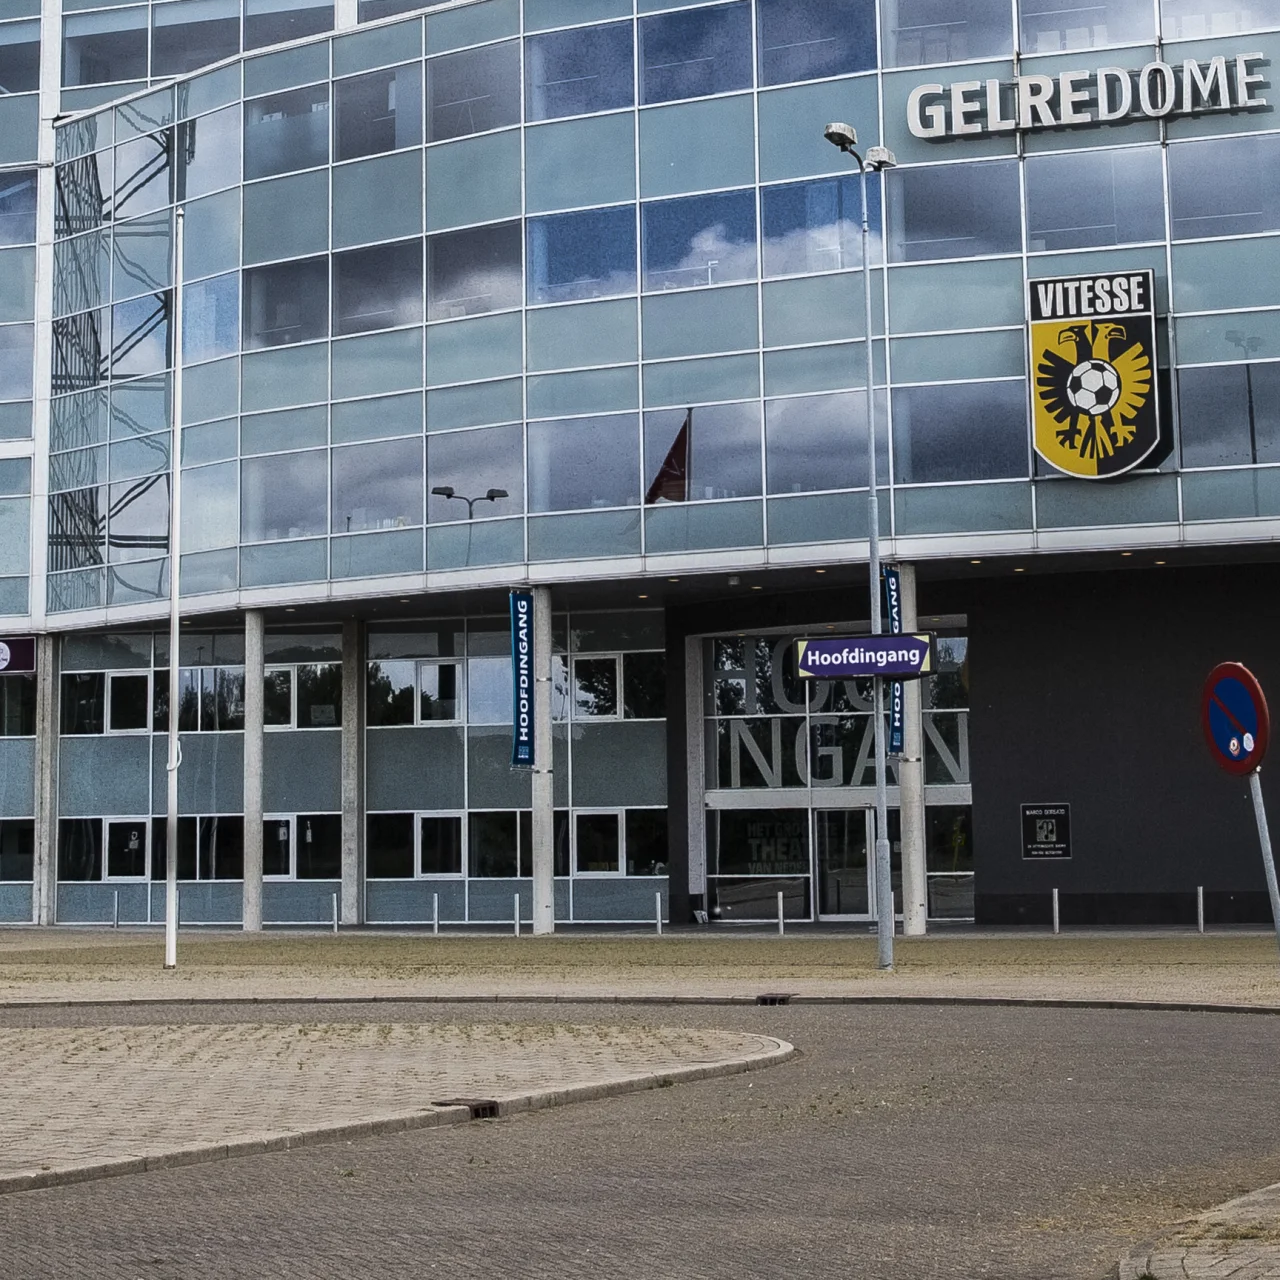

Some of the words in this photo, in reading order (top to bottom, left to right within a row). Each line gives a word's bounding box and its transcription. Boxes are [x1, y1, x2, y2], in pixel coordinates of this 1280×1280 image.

[906, 51, 1269, 138] GELREDOME
[1036, 276, 1145, 318] VITESSE
[517, 600, 529, 741] HOOFDINGANG
[807, 647, 921, 668] Hoofdingang
[888, 576, 901, 727] HOOGANG
